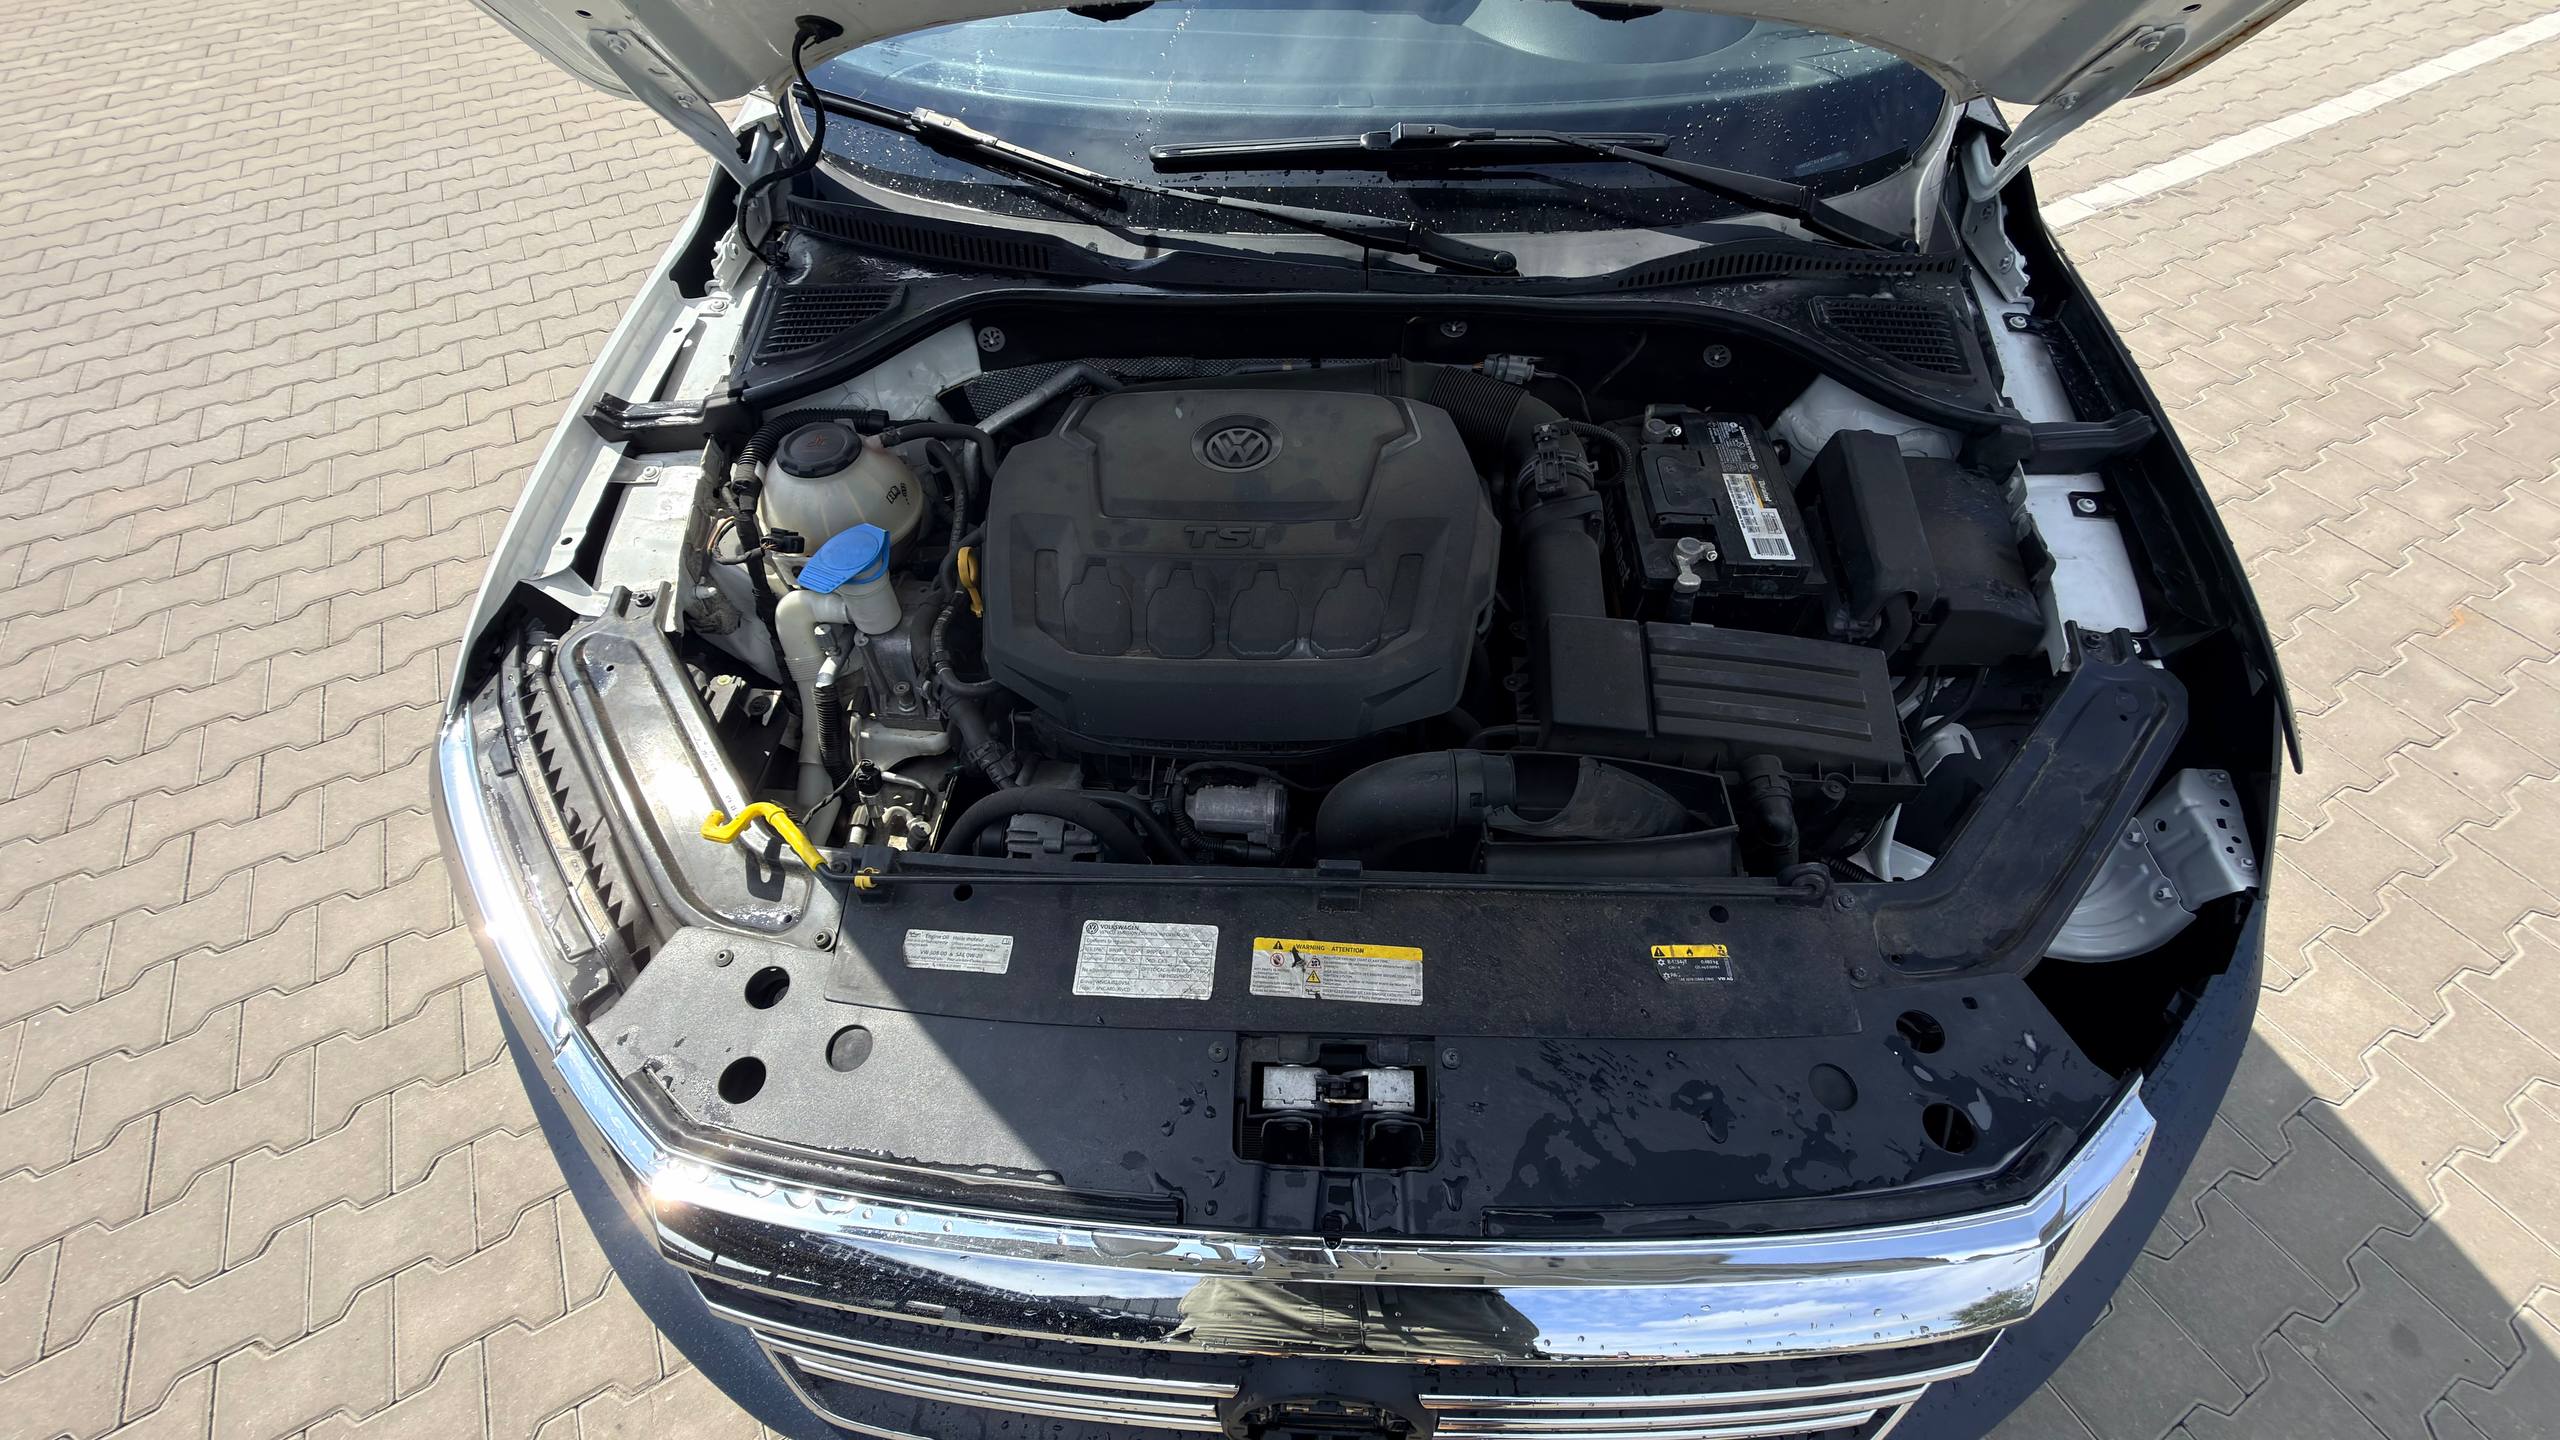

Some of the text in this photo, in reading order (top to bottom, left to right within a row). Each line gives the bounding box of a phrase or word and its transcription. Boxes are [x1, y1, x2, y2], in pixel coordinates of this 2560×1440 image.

[1206, 427, 1269, 468] VW
[1184, 525, 1266, 549] TSI
[1295, 943, 1365, 954] WARNING ATTENTION
